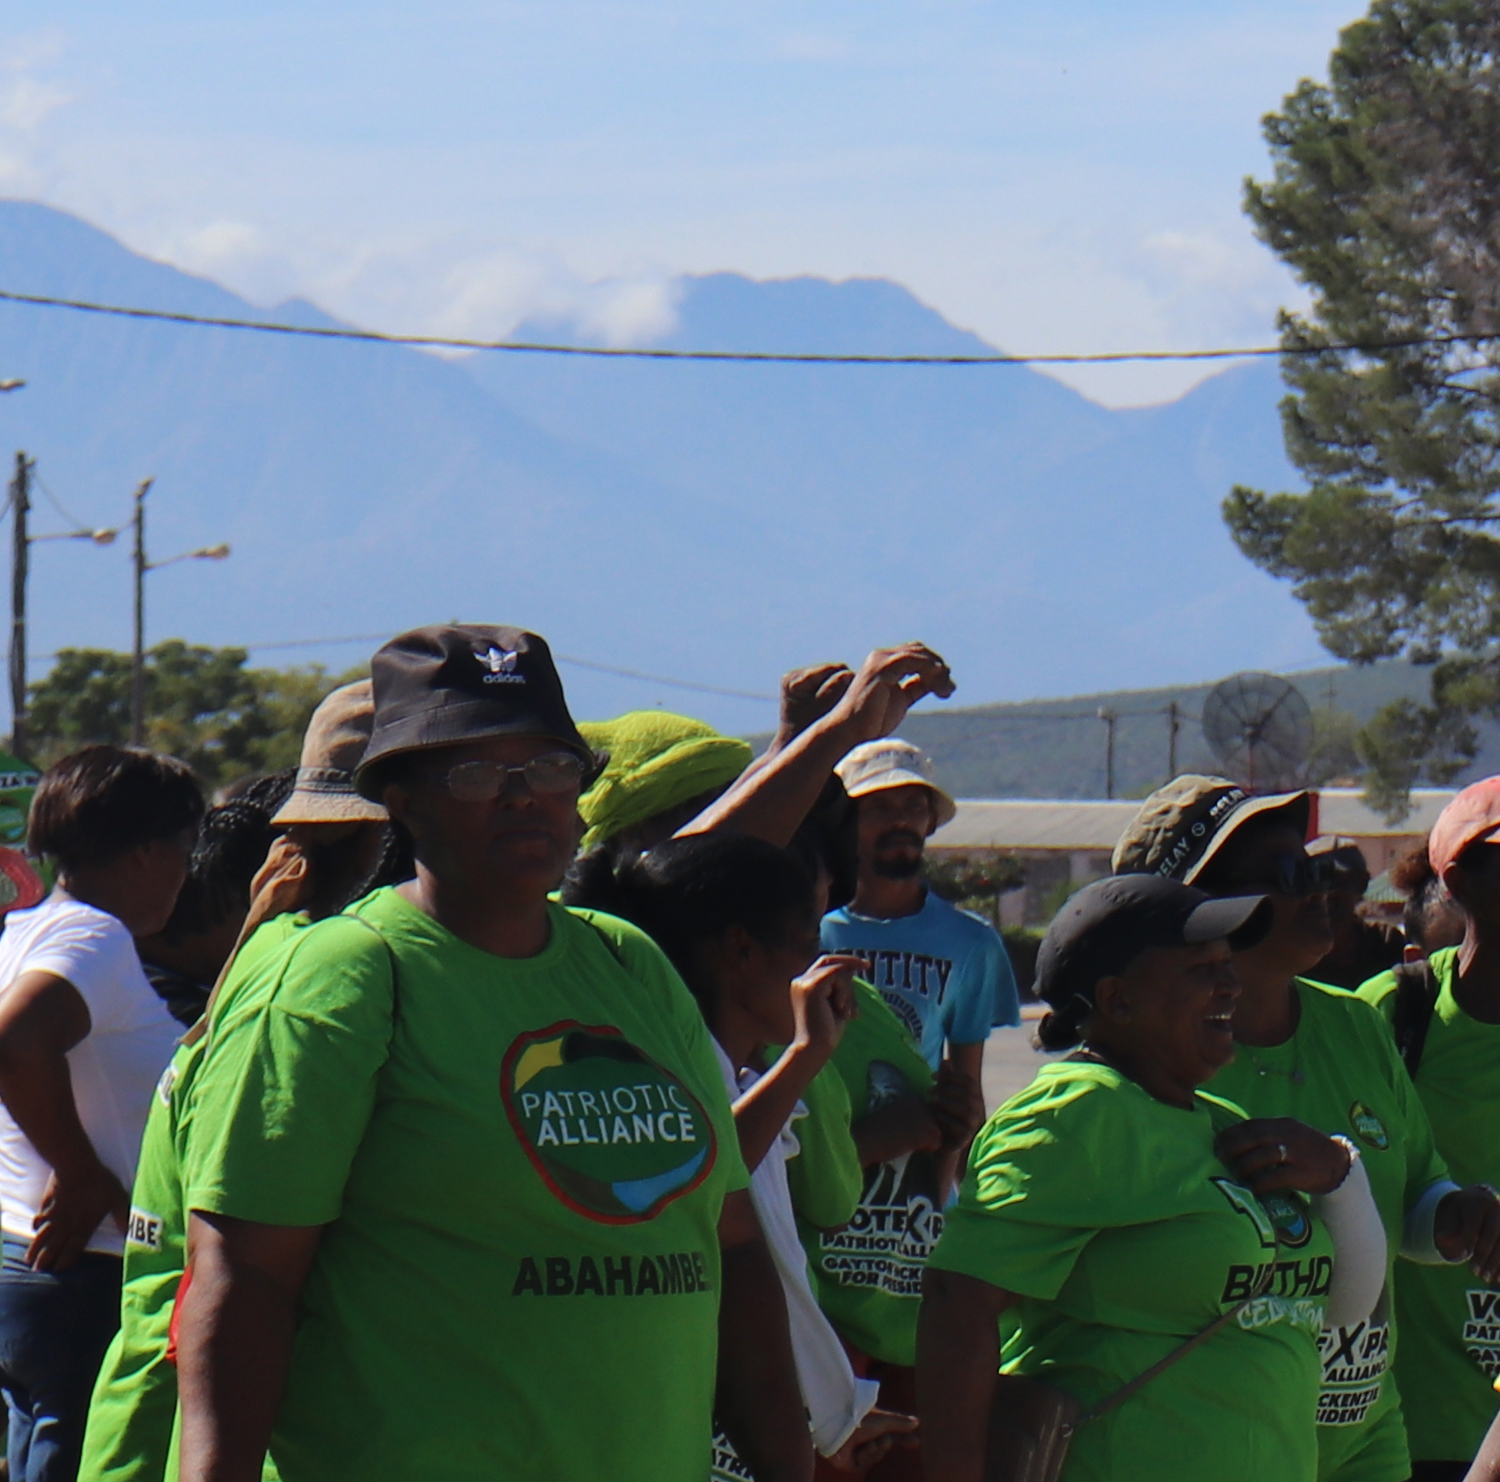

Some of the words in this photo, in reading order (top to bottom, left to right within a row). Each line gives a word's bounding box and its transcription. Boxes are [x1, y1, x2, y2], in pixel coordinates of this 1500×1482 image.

[520, 1083, 689, 1118] PATRIOTIC
[536, 1111, 697, 1147] ALLIANCE
[850, 1208, 907, 1233] OTE
[822, 1234, 899, 1250] PATRIOT
[511, 1251, 709, 1298] ABAHAMBE
[841, 1272, 879, 1285] FOR
[1324, 1321, 1366, 1371] X
[1318, 1387, 1379, 1408] CKENZIE
